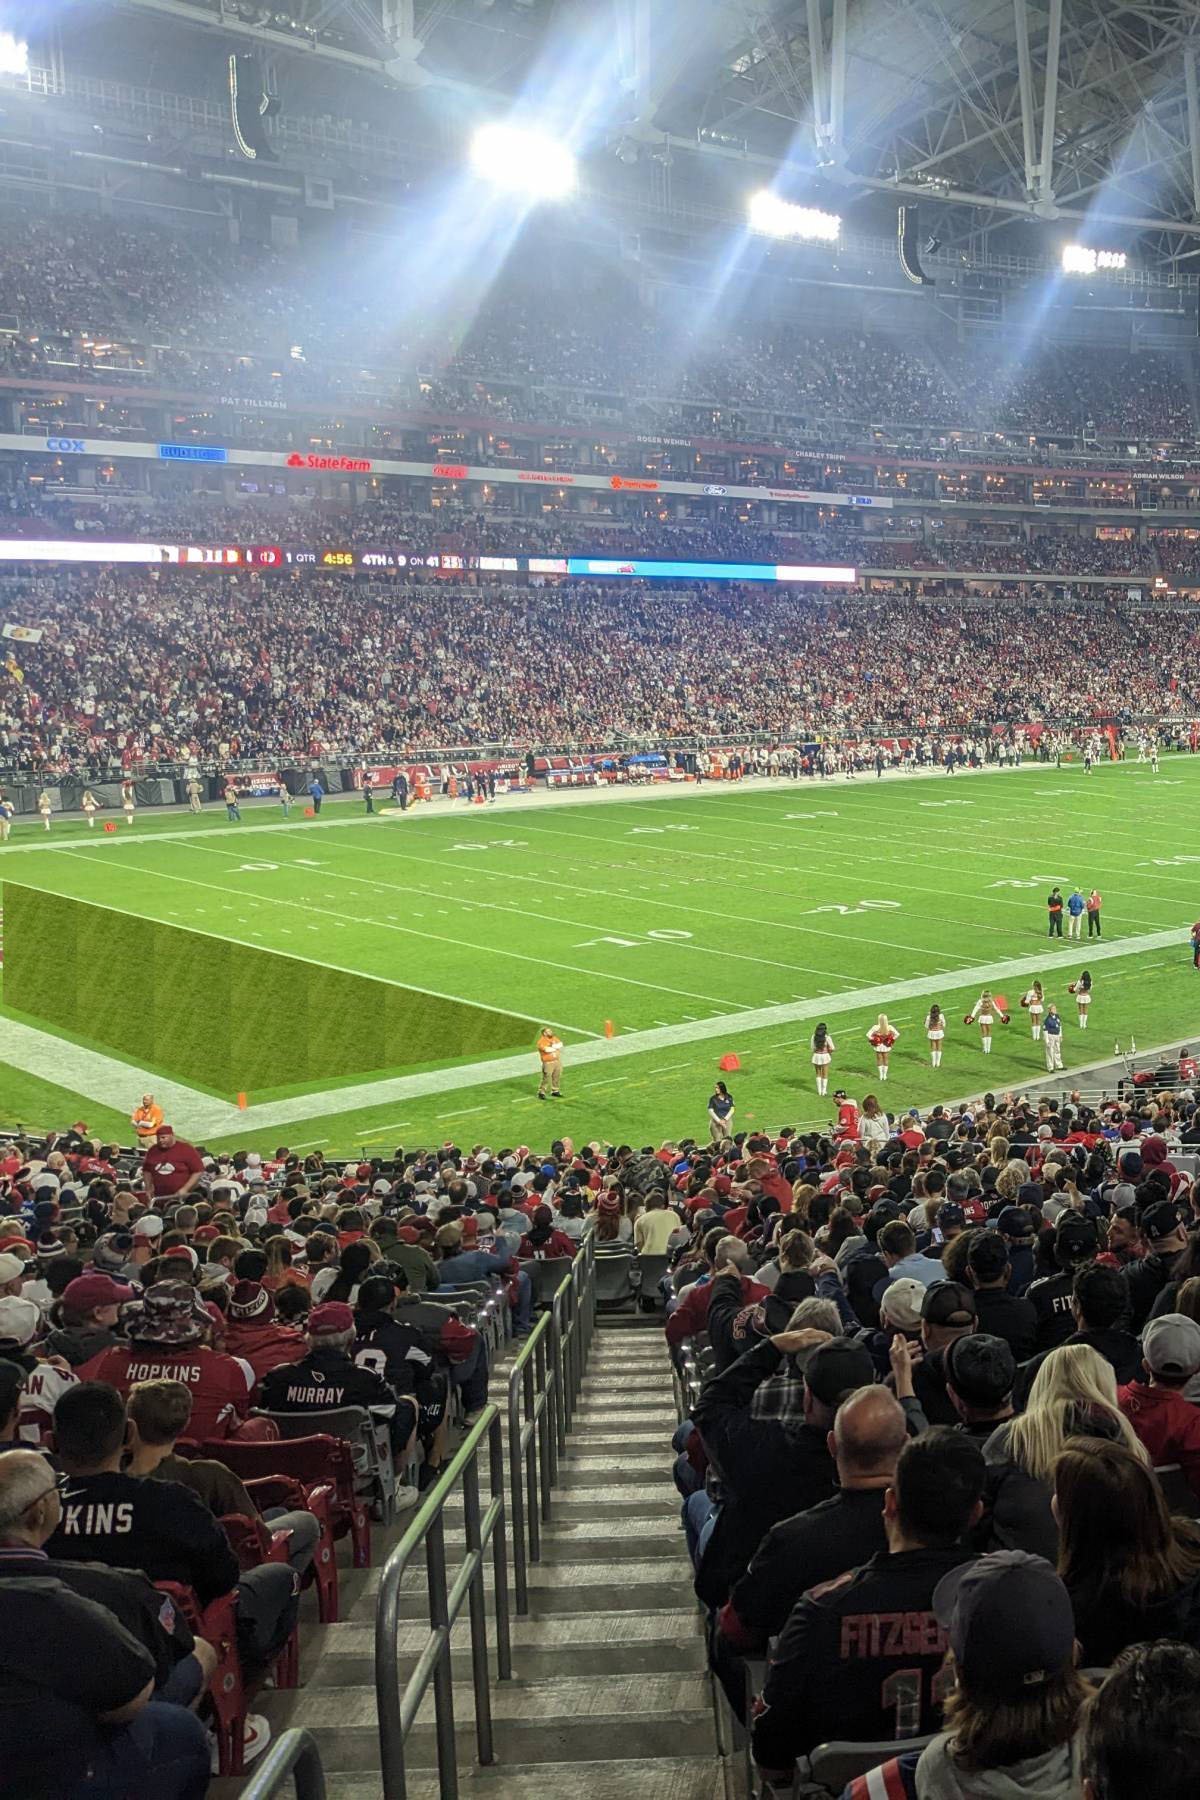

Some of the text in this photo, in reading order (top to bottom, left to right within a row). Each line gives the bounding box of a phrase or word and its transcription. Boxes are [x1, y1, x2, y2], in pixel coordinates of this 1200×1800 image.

[221, 396, 288, 409] PAT TILLMAN
[47, 438, 85, 452] COX
[286, 552, 353, 565] 1 QTR 4:56
[362, 554, 439, 567] 4TH & 9 ON 41
[126, 1362, 201, 1383] HOPKINS
[286, 1385, 345, 1404] MURRAY
